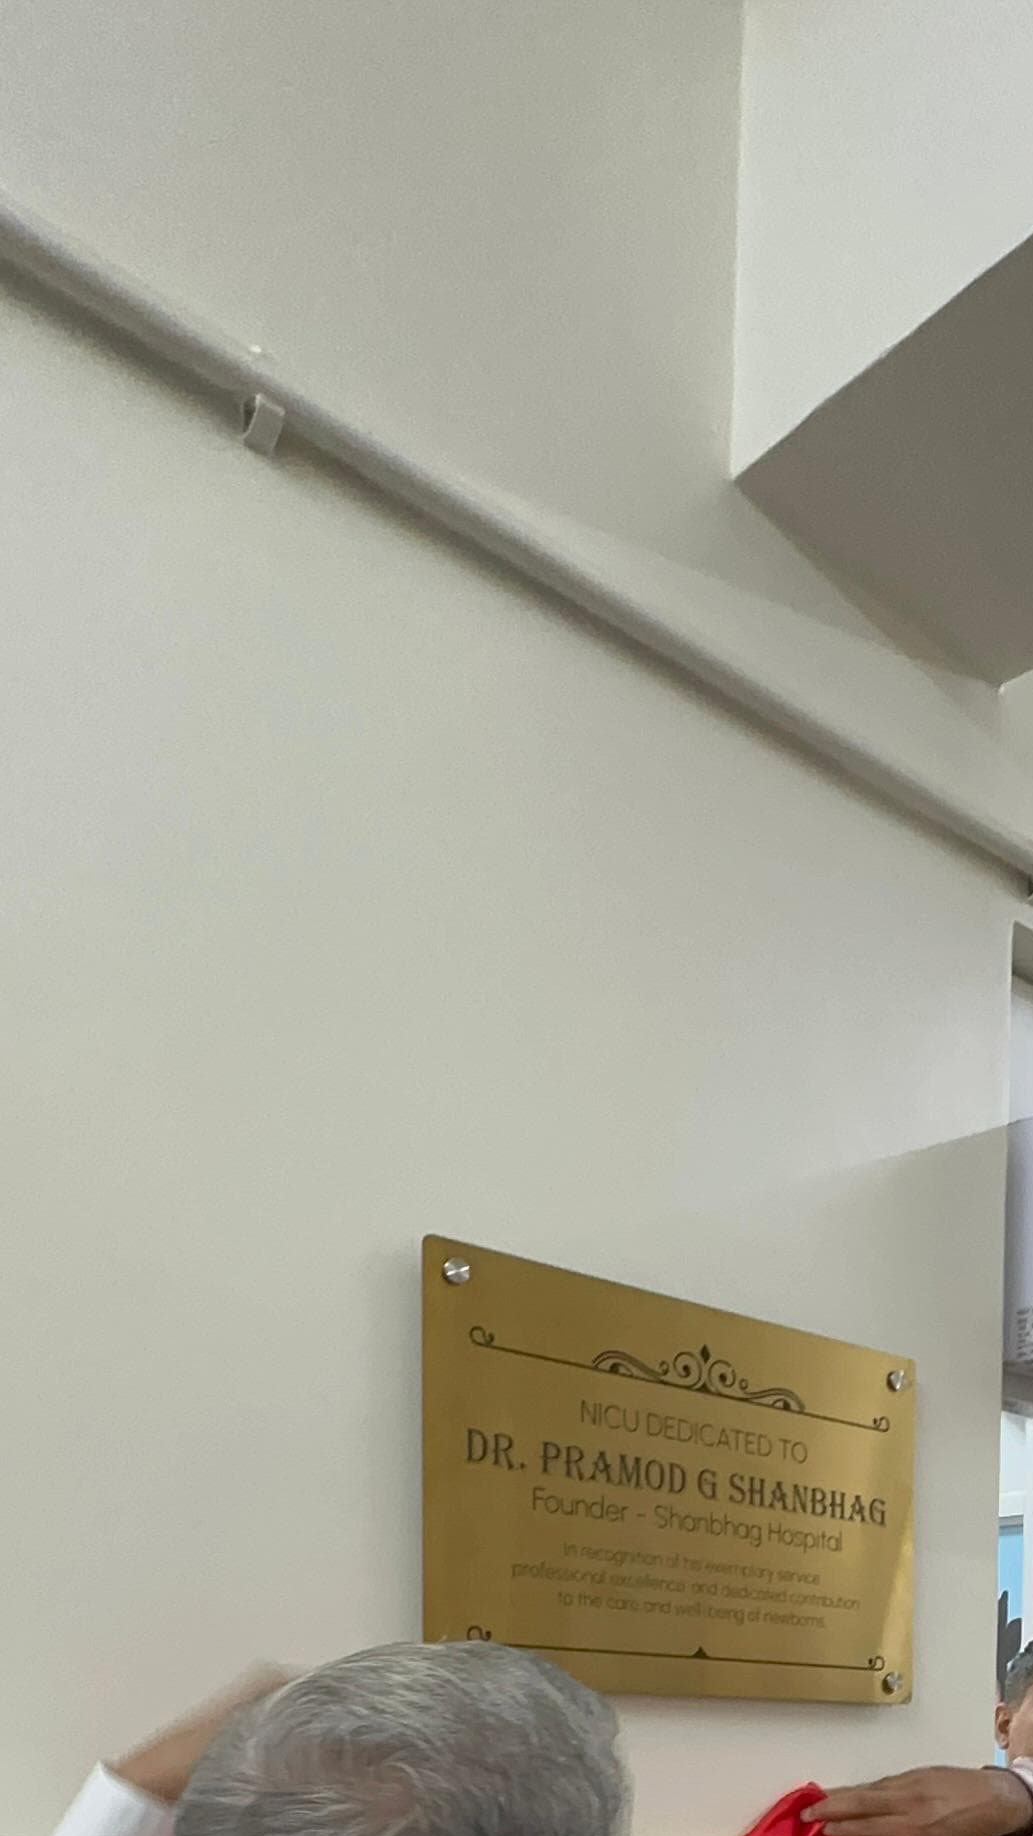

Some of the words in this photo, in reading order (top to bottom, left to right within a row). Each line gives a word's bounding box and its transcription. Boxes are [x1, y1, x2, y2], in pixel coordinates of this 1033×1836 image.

[580, 1400, 639, 1432] NICU
[646, 1412, 772, 1457] DEDICATED
[779, 1438, 808, 1464] TO
[466, 1428, 527, 1470] DR.
[541, 1441, 686, 1494] PRAMOD
[697, 1468, 717, 1500] G
[729, 1472, 887, 1527] SHANBHAG
[532, 1486, 629, 1522] Founder
[654, 1505, 762, 1547] Shanbhag
[768, 1523, 843, 1554] Hospital
[511, 1560, 606, 1584] professional
[609, 1573, 686, 1593] excellence
[690, 1581, 717, 1596] and
[721, 1585, 786, 1604] dedicated
[789, 1592, 861, 1611] contribution
[563, 1540, 577, 1556] In
[580, 1545, 663, 1566] recognition
[666, 1553, 680, 1568] of
[704, 1561, 774, 1583] exemplary
[777, 1570, 820, 1586] service
[557, 1591, 574, 1607] to
[578, 1592, 603, 1608] the
[606, 1596, 640, 1611] care
[644, 1600, 671, 1615] and
[747, 1610, 760, 1624] of
